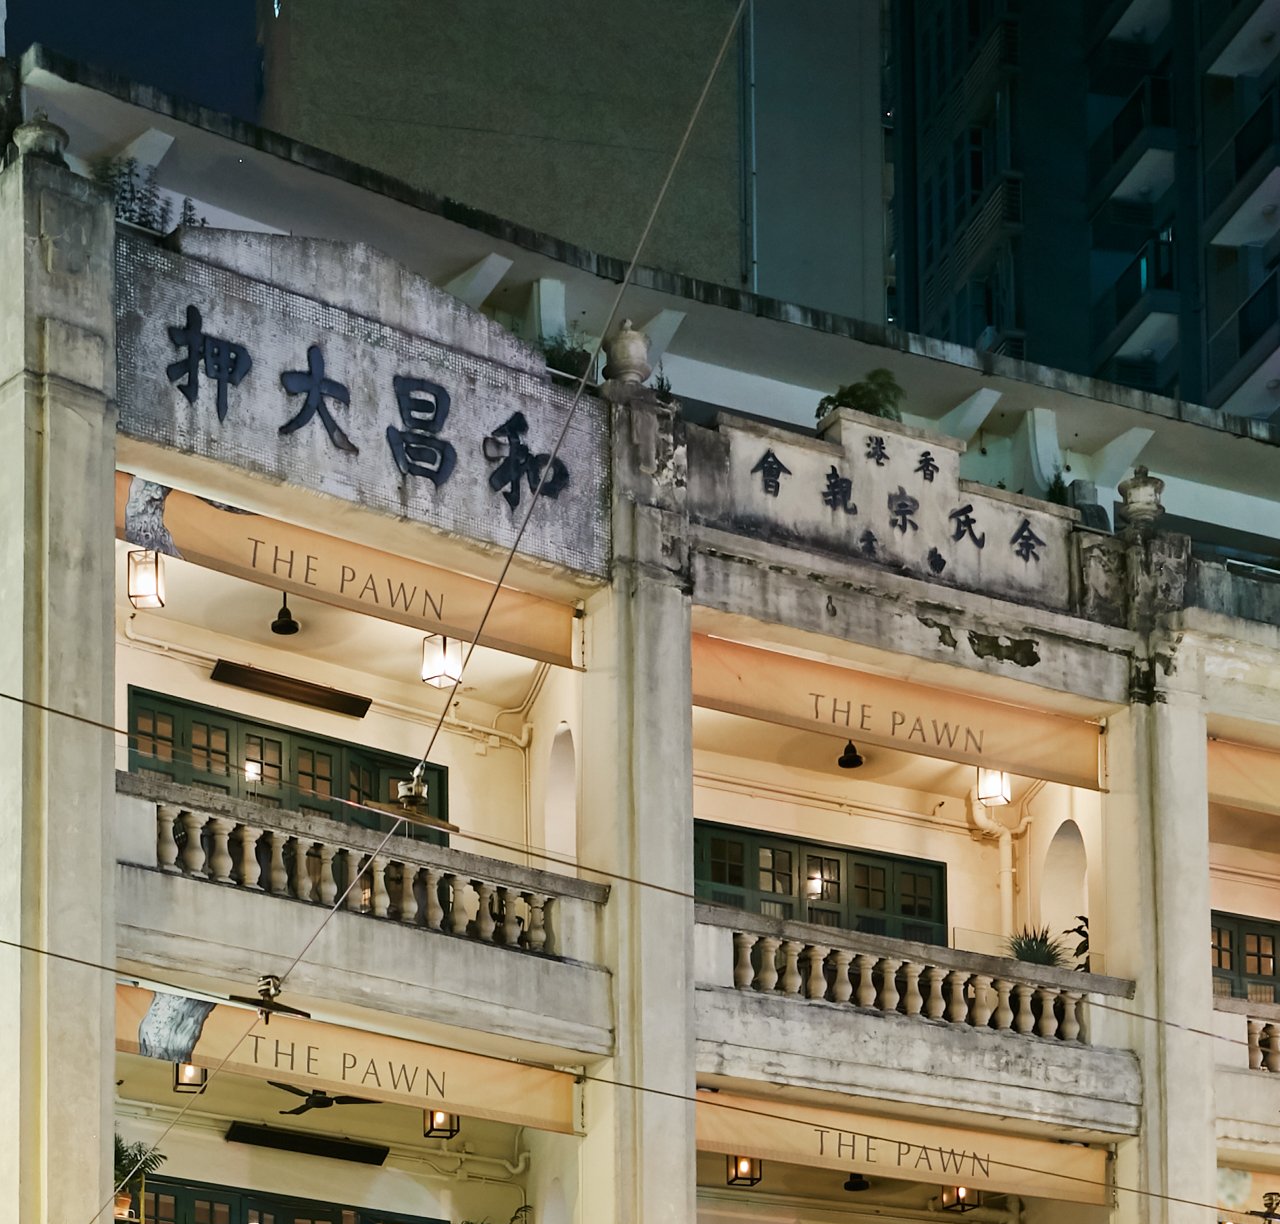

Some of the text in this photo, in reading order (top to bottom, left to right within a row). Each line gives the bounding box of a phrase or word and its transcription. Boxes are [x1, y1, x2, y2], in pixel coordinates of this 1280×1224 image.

[247, 537, 446, 621] THE PAWN
[808, 692, 985, 754] THE PAWN
[247, 1034, 446, 1098] THE PAWN
[814, 1128, 990, 1178] THE PAWN
